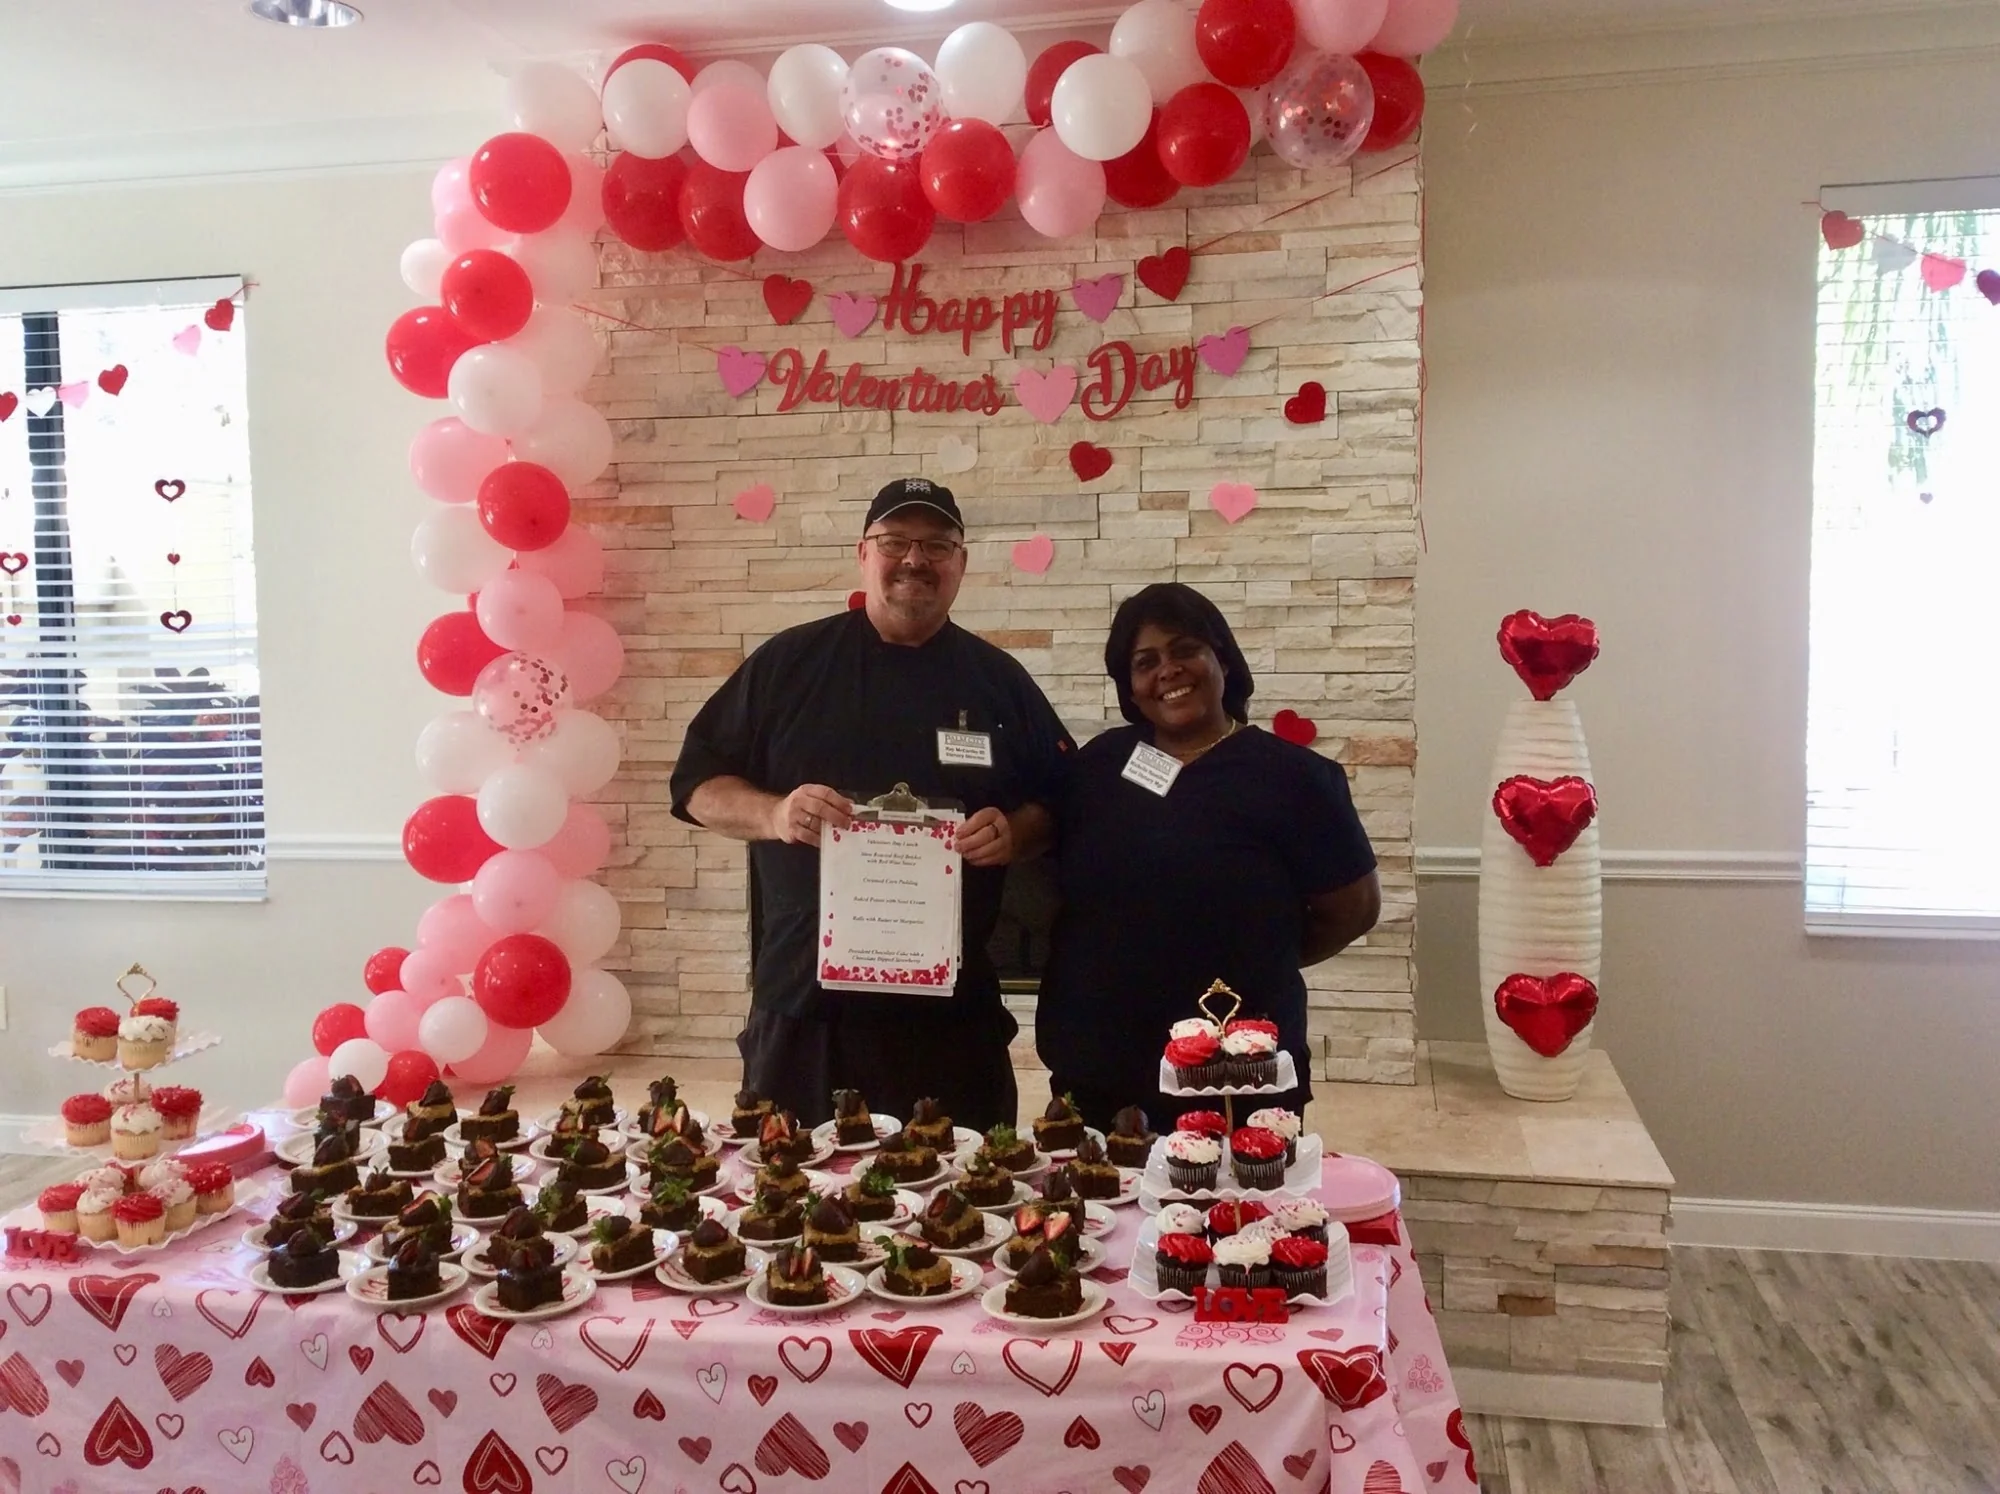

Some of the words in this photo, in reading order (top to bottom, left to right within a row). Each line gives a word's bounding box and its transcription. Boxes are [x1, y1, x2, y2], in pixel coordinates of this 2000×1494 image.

[882, 260, 1059, 356] Happy
[1081, 341, 1196, 421] Day
[4, 1226, 78, 1262] LOVE
[1194, 1286, 1289, 1324] LOVE
